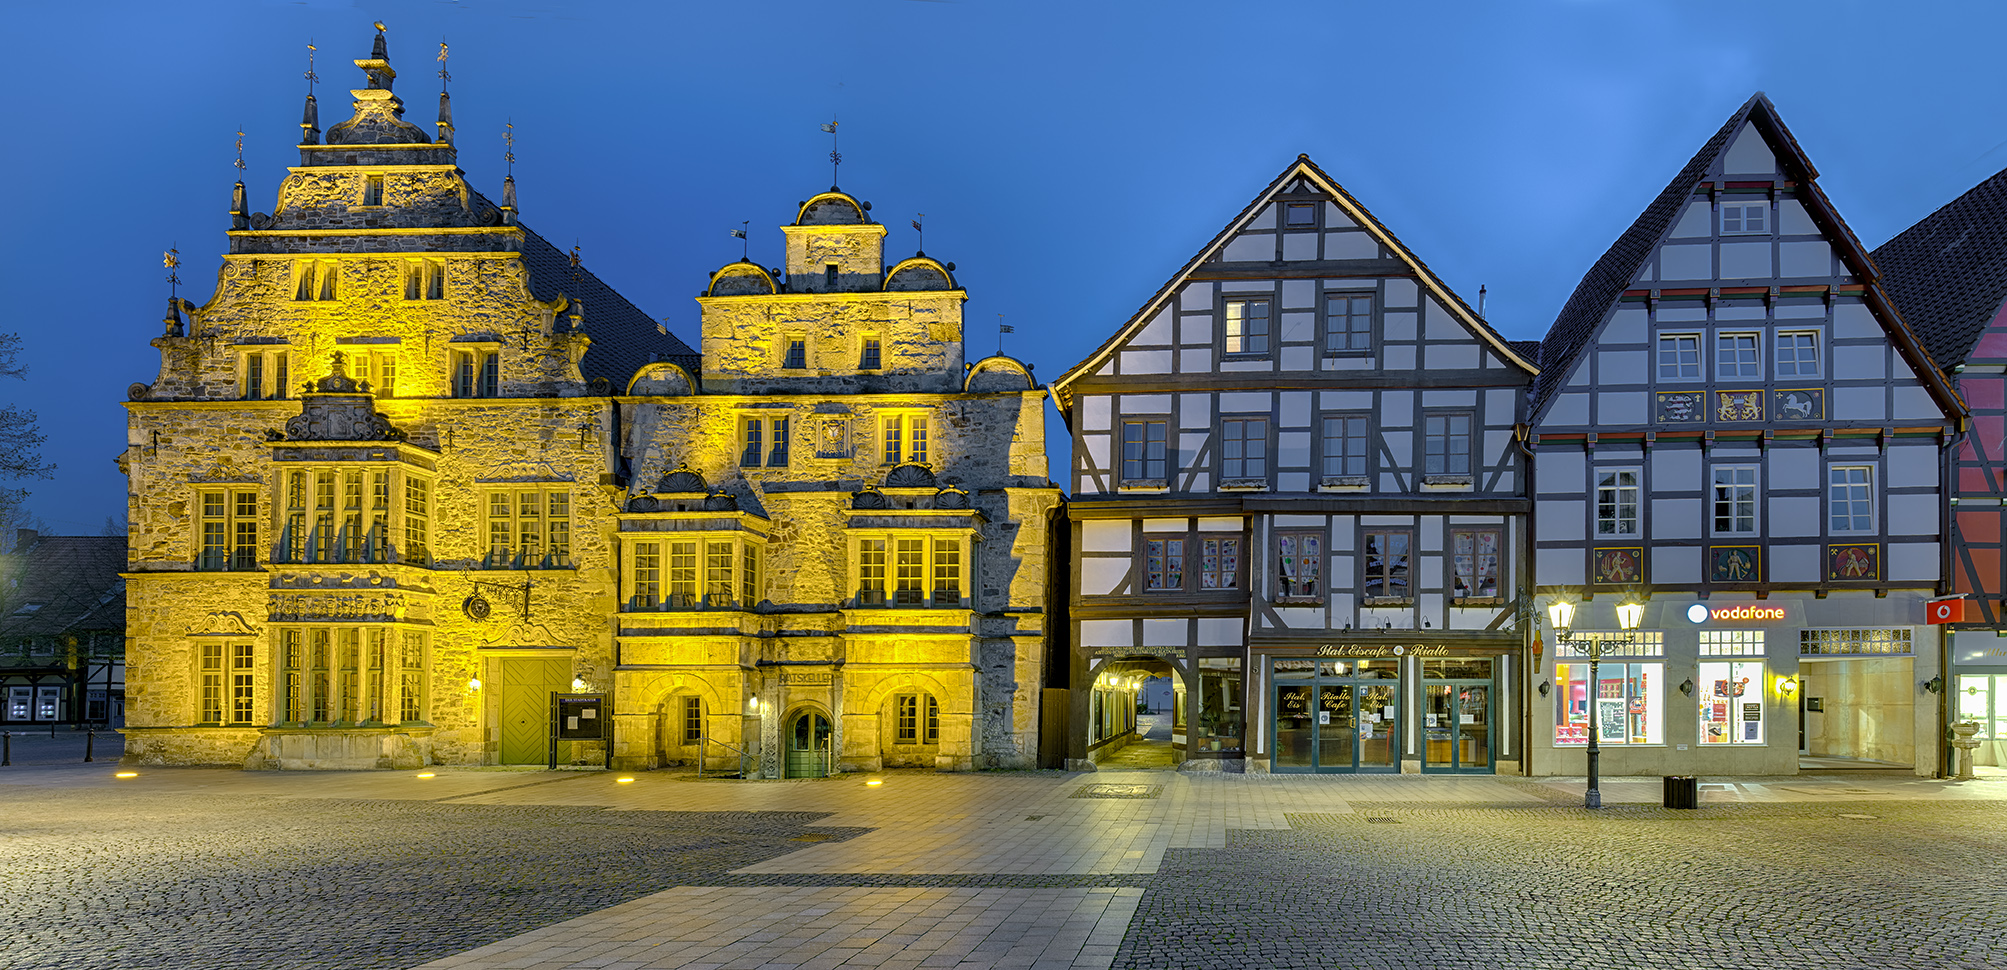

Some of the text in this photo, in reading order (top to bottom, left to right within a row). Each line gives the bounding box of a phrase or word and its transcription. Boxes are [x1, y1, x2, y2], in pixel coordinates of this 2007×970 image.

[1710, 605, 1785, 619] vodafone
[1317, 644, 1449, 658] Ital. Eiscafe Rialto
[1252, 665, 1259, 674] 5
[779, 673, 834, 683] RATSKELLER
[1283, 691, 1306, 701] Ital.
[1320, 691, 1351, 701] Rialto
[1366, 691, 1388, 701] Ital.
[1286, 700, 1301, 709] Eis
[1324, 700, 1348, 711] Cafe
[1369, 700, 1385, 709] Eis
